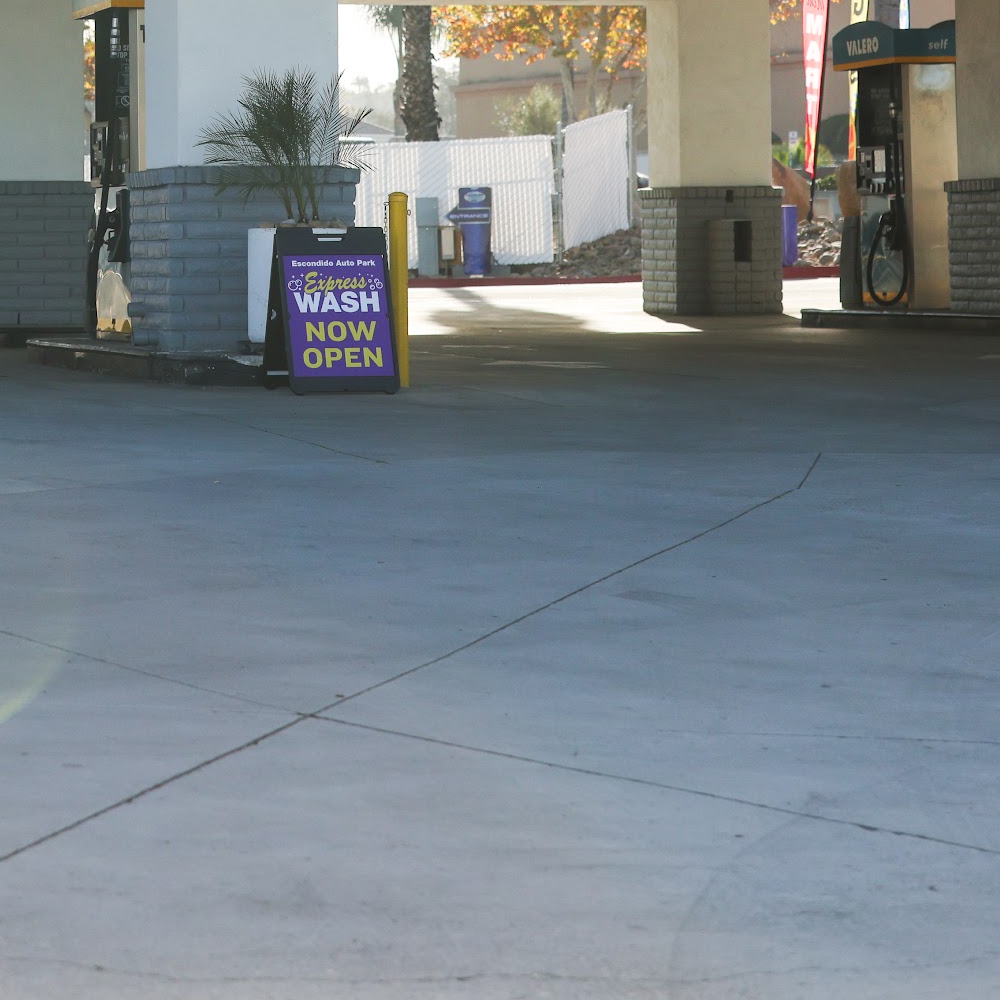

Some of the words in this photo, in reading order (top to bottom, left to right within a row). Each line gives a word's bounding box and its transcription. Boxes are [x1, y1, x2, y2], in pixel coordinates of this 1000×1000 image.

[846, 36, 879, 57] VALERO
[928, 38, 949, 50] self
[335, 259, 355, 267] Auto
[356, 259, 376, 267] Park
[304, 271, 368, 296] Express
[294, 291, 381, 313] WASH
[305, 320, 377, 342] NOW
[303, 347, 383, 369] OPEN
